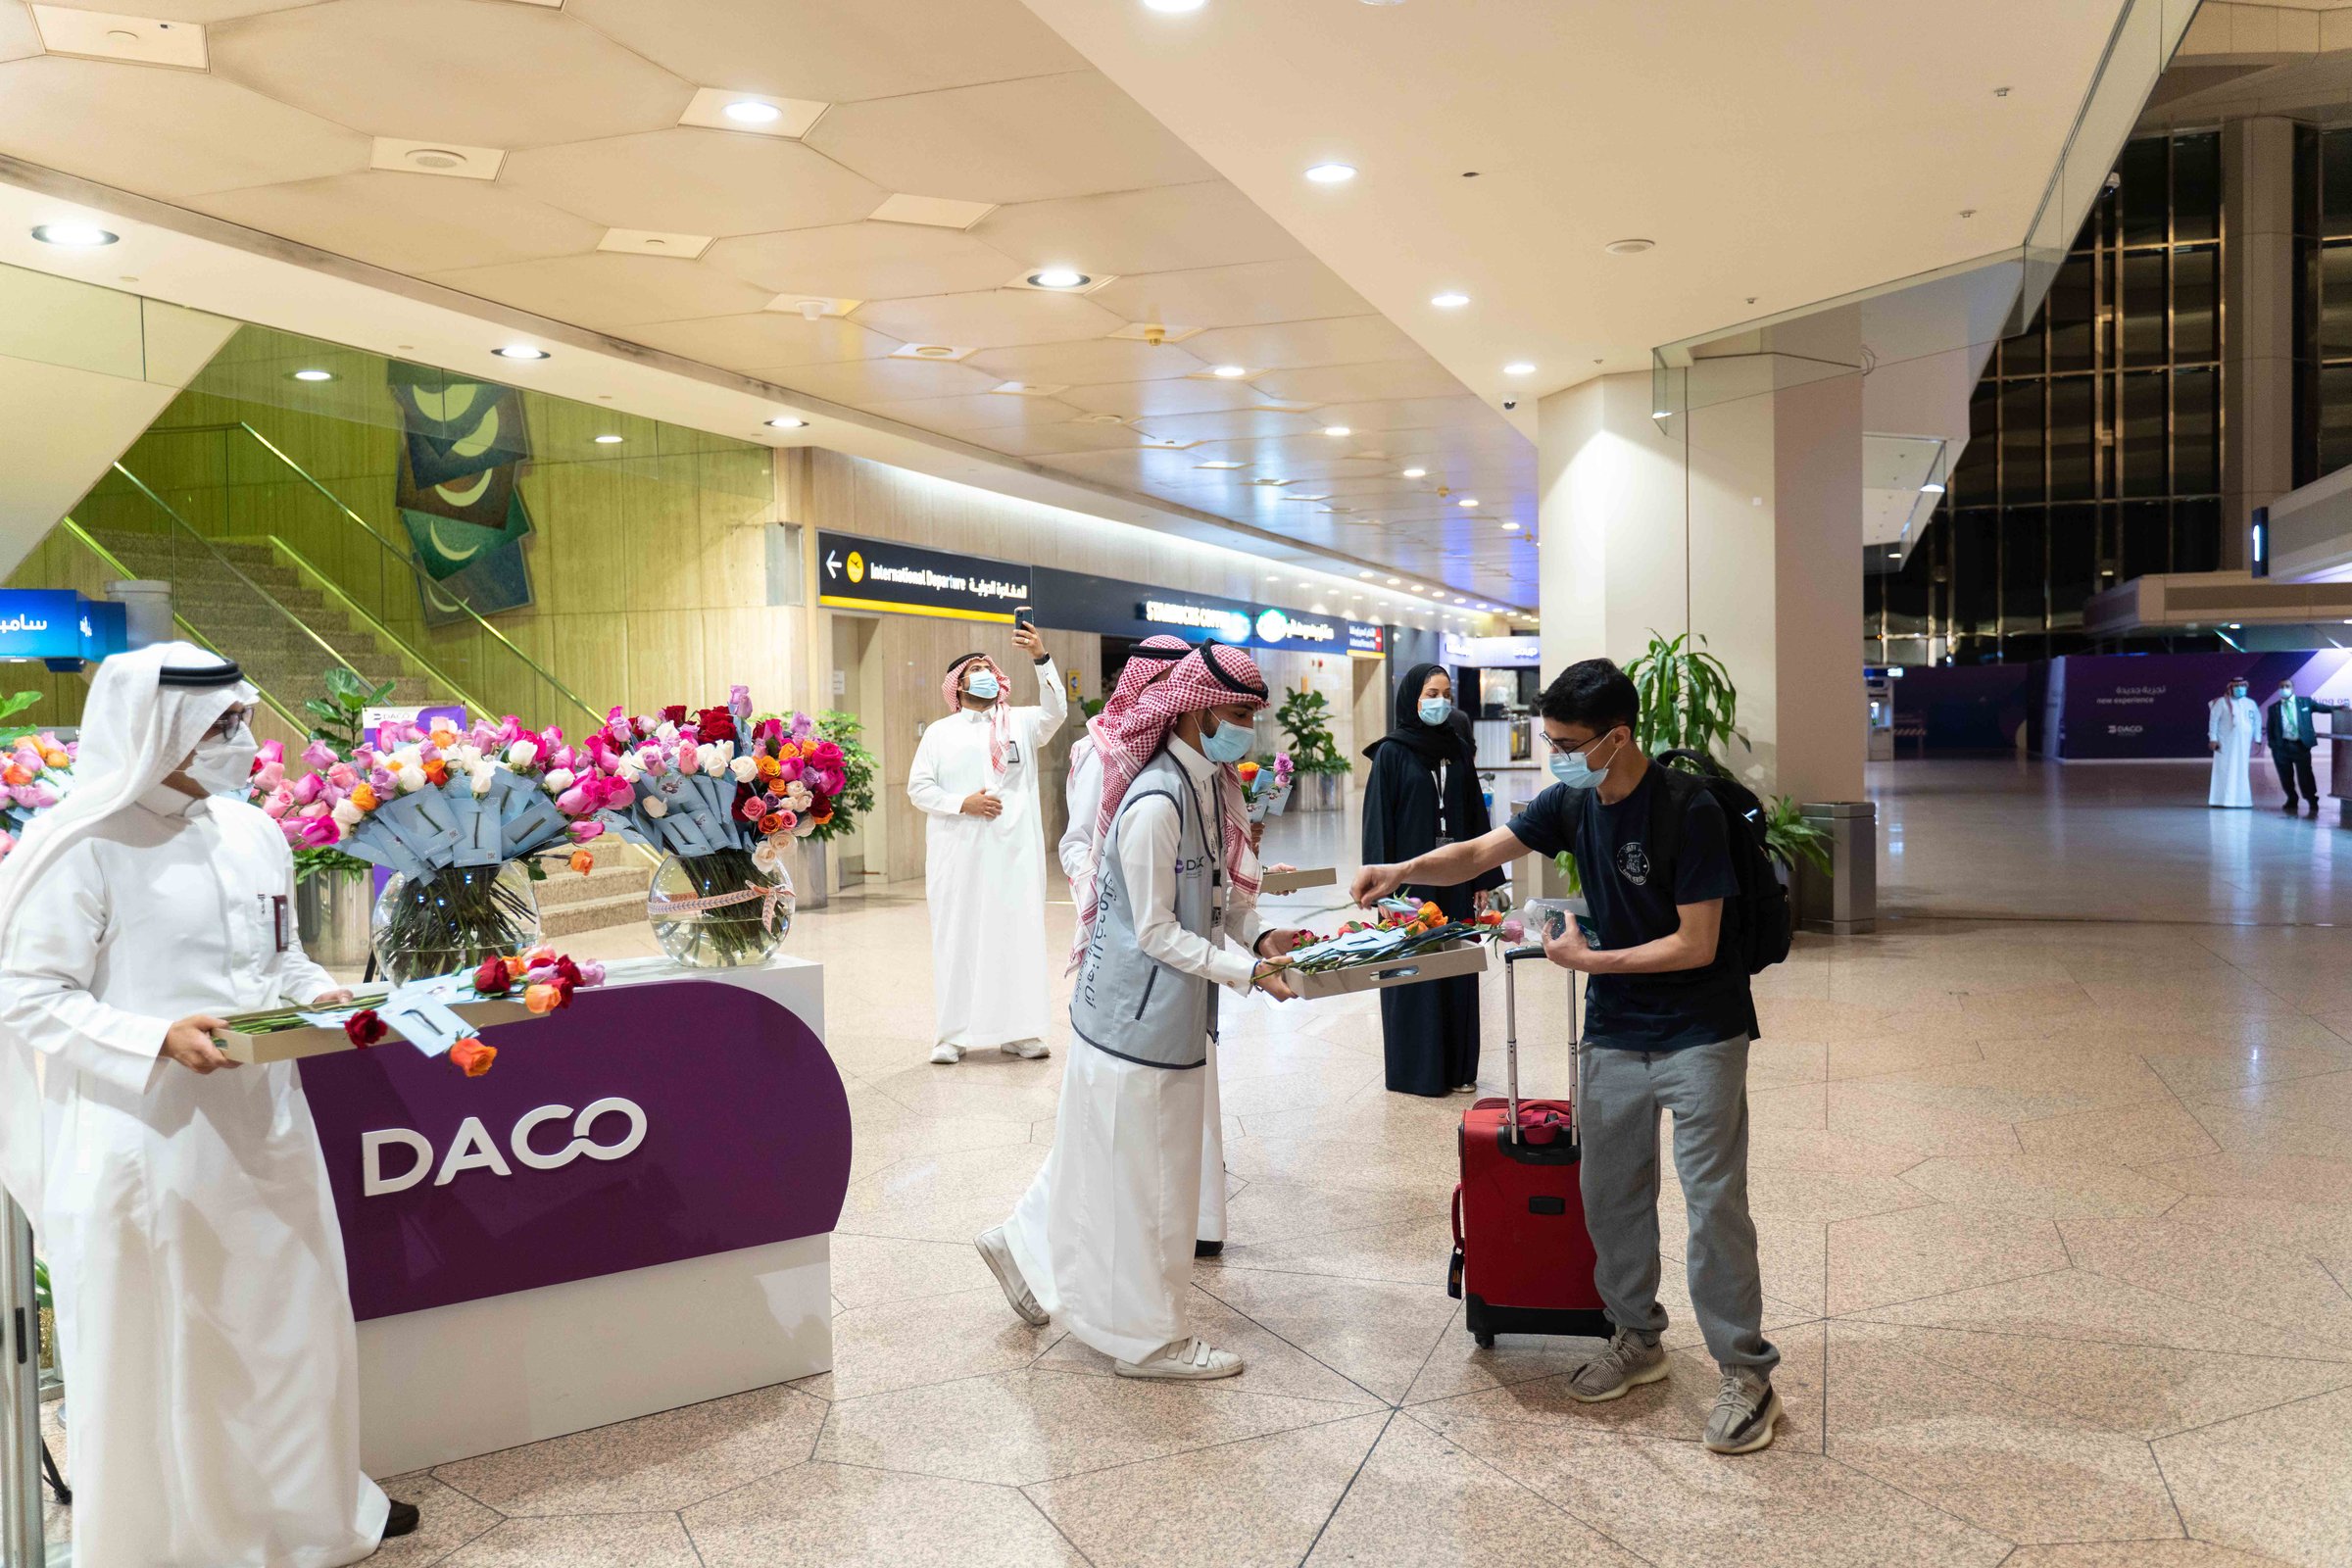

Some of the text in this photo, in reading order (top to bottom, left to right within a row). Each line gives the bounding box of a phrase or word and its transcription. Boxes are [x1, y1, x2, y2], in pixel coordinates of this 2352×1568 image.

[870, 562, 966, 591] International Departure
[968, 576, 1028, 600] المغادرة الدولية
[0, 612, 48, 634] سامب
[2113, 697, 2155, 706] experience
[362, 1097, 648, 1197] DACO
